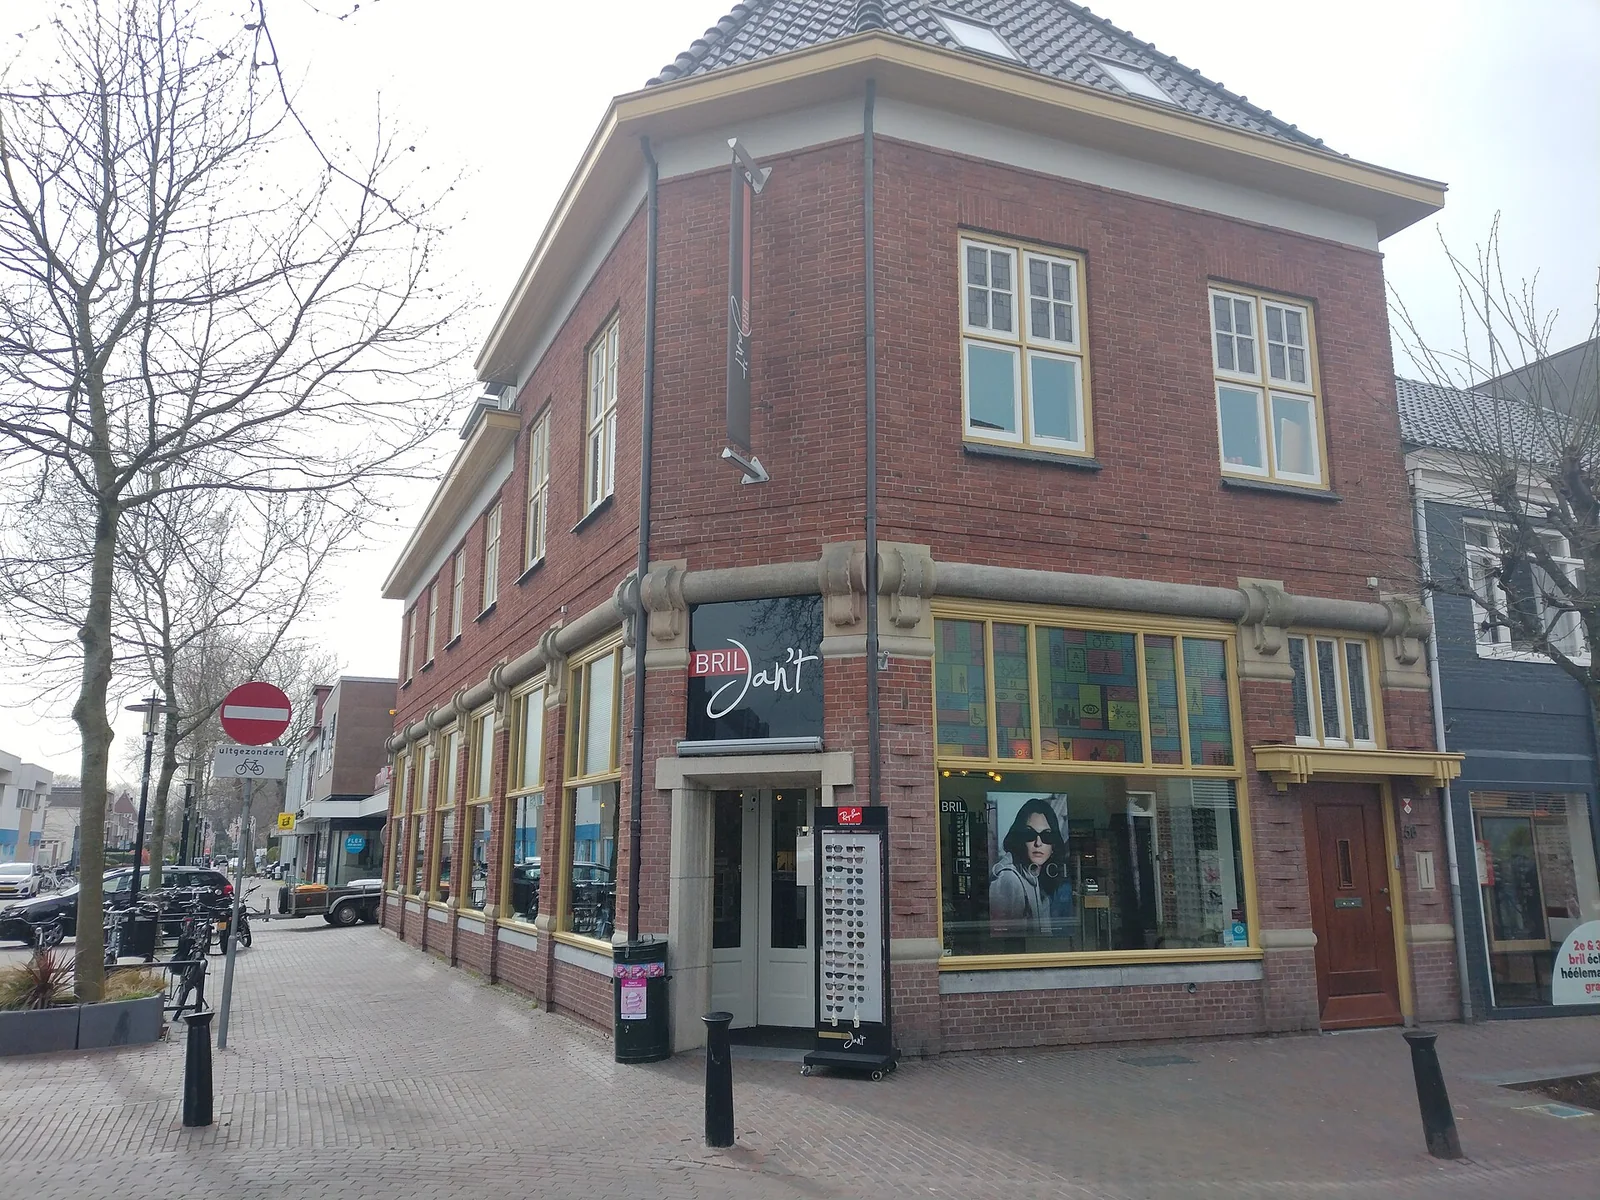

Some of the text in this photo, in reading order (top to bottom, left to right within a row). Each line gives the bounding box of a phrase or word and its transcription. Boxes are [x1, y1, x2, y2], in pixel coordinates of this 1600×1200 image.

[695, 651, 746, 674] BRIL
[219, 747, 285, 757] uitgezonderd
[941, 801, 966, 813] BRIL
[1573, 940, 1586, 951] 2e
[1587, 940, 1594, 951] &
[1568, 953, 1585, 965] bril
[1585, 982, 1600, 994] gra
